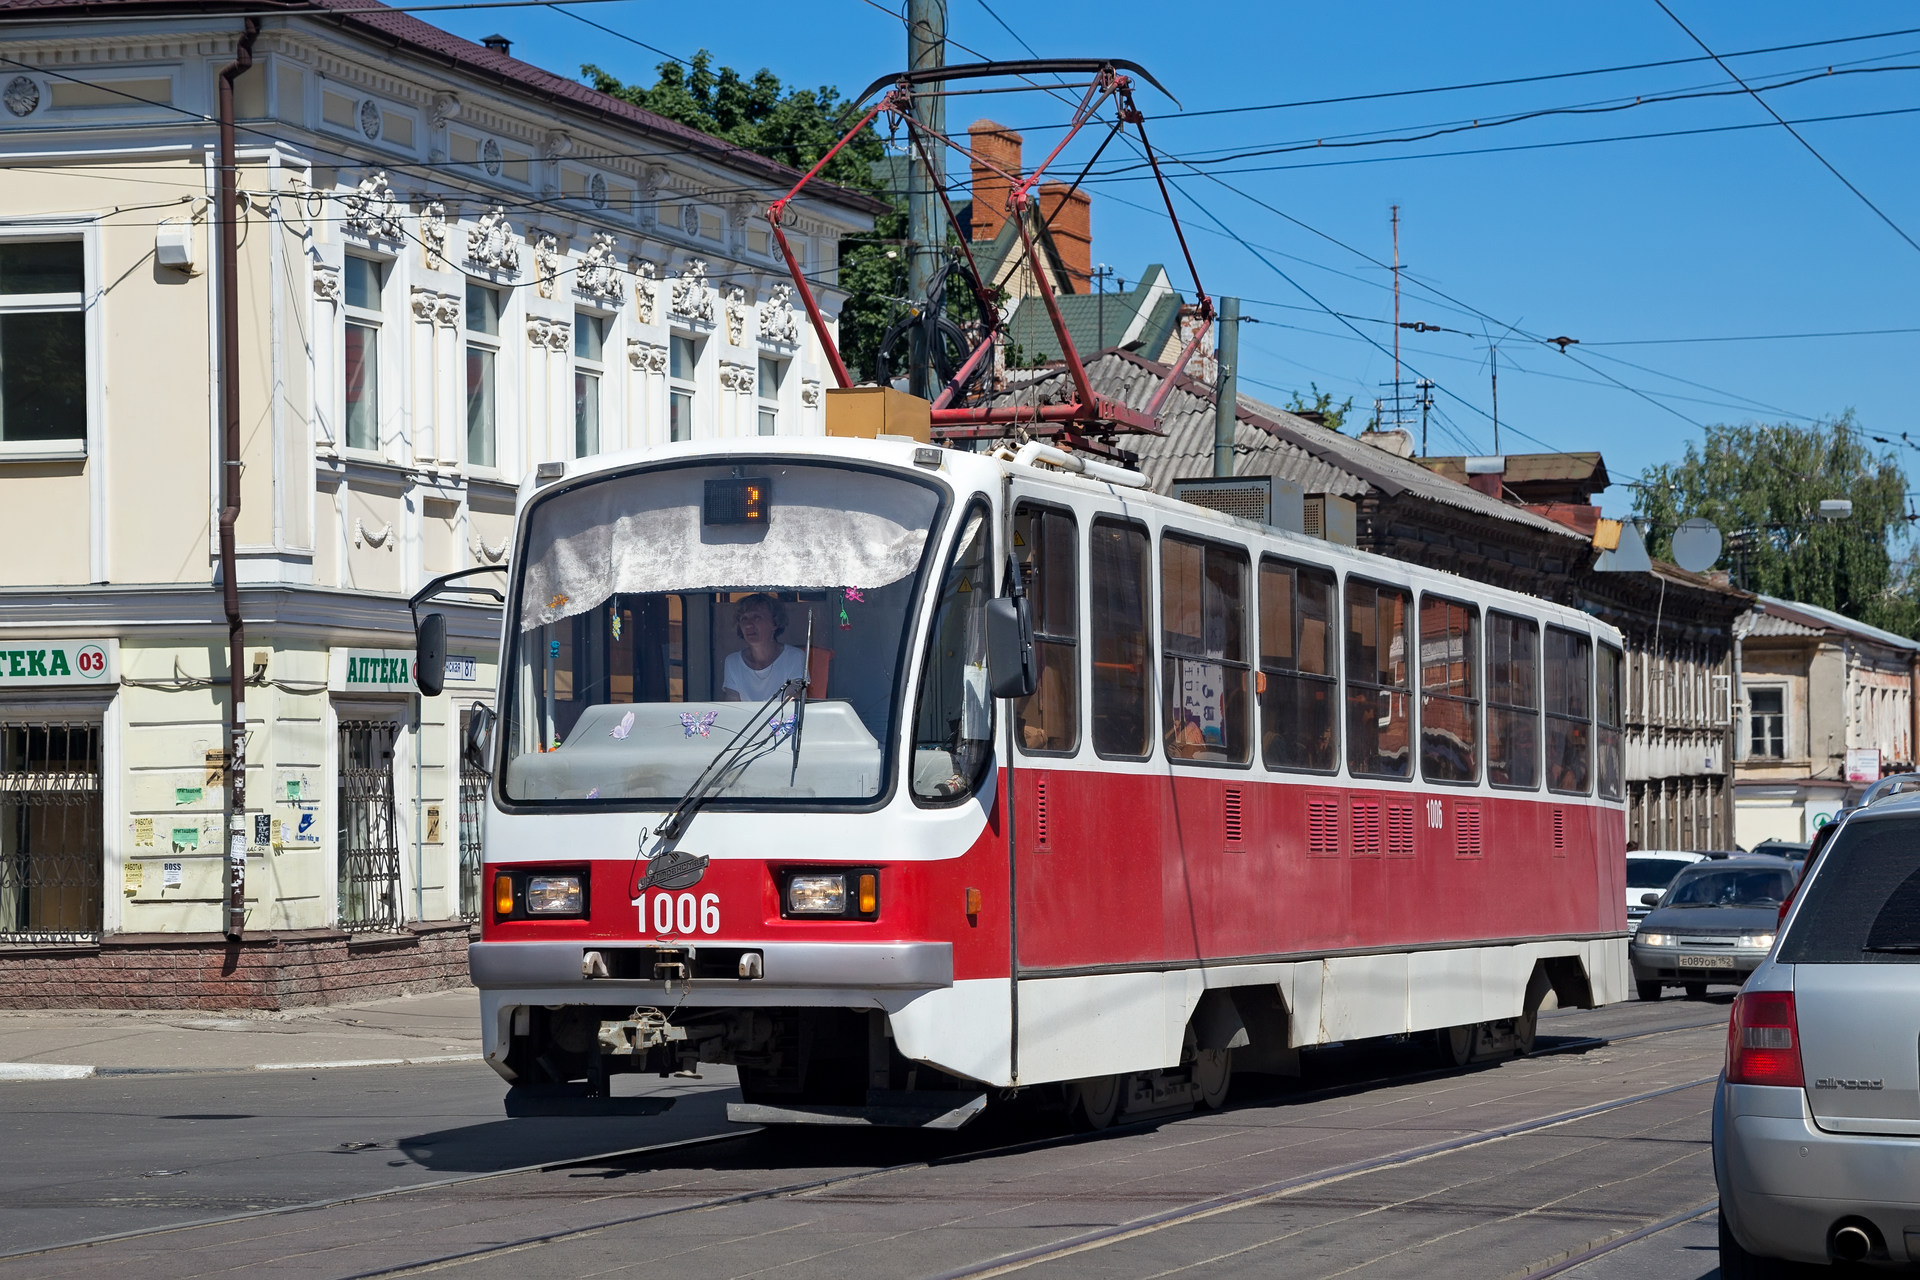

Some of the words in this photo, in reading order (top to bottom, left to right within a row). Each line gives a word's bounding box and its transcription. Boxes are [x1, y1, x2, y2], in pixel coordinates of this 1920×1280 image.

[79, 652, 104, 671] 03
[347, 657, 409, 683] АПТЕКА
[465, 660, 474, 677] 87
[1426, 799, 1443, 829] 1006
[631, 892, 720, 935] 1006
[1815, 1077, 1884, 1090] allroad
